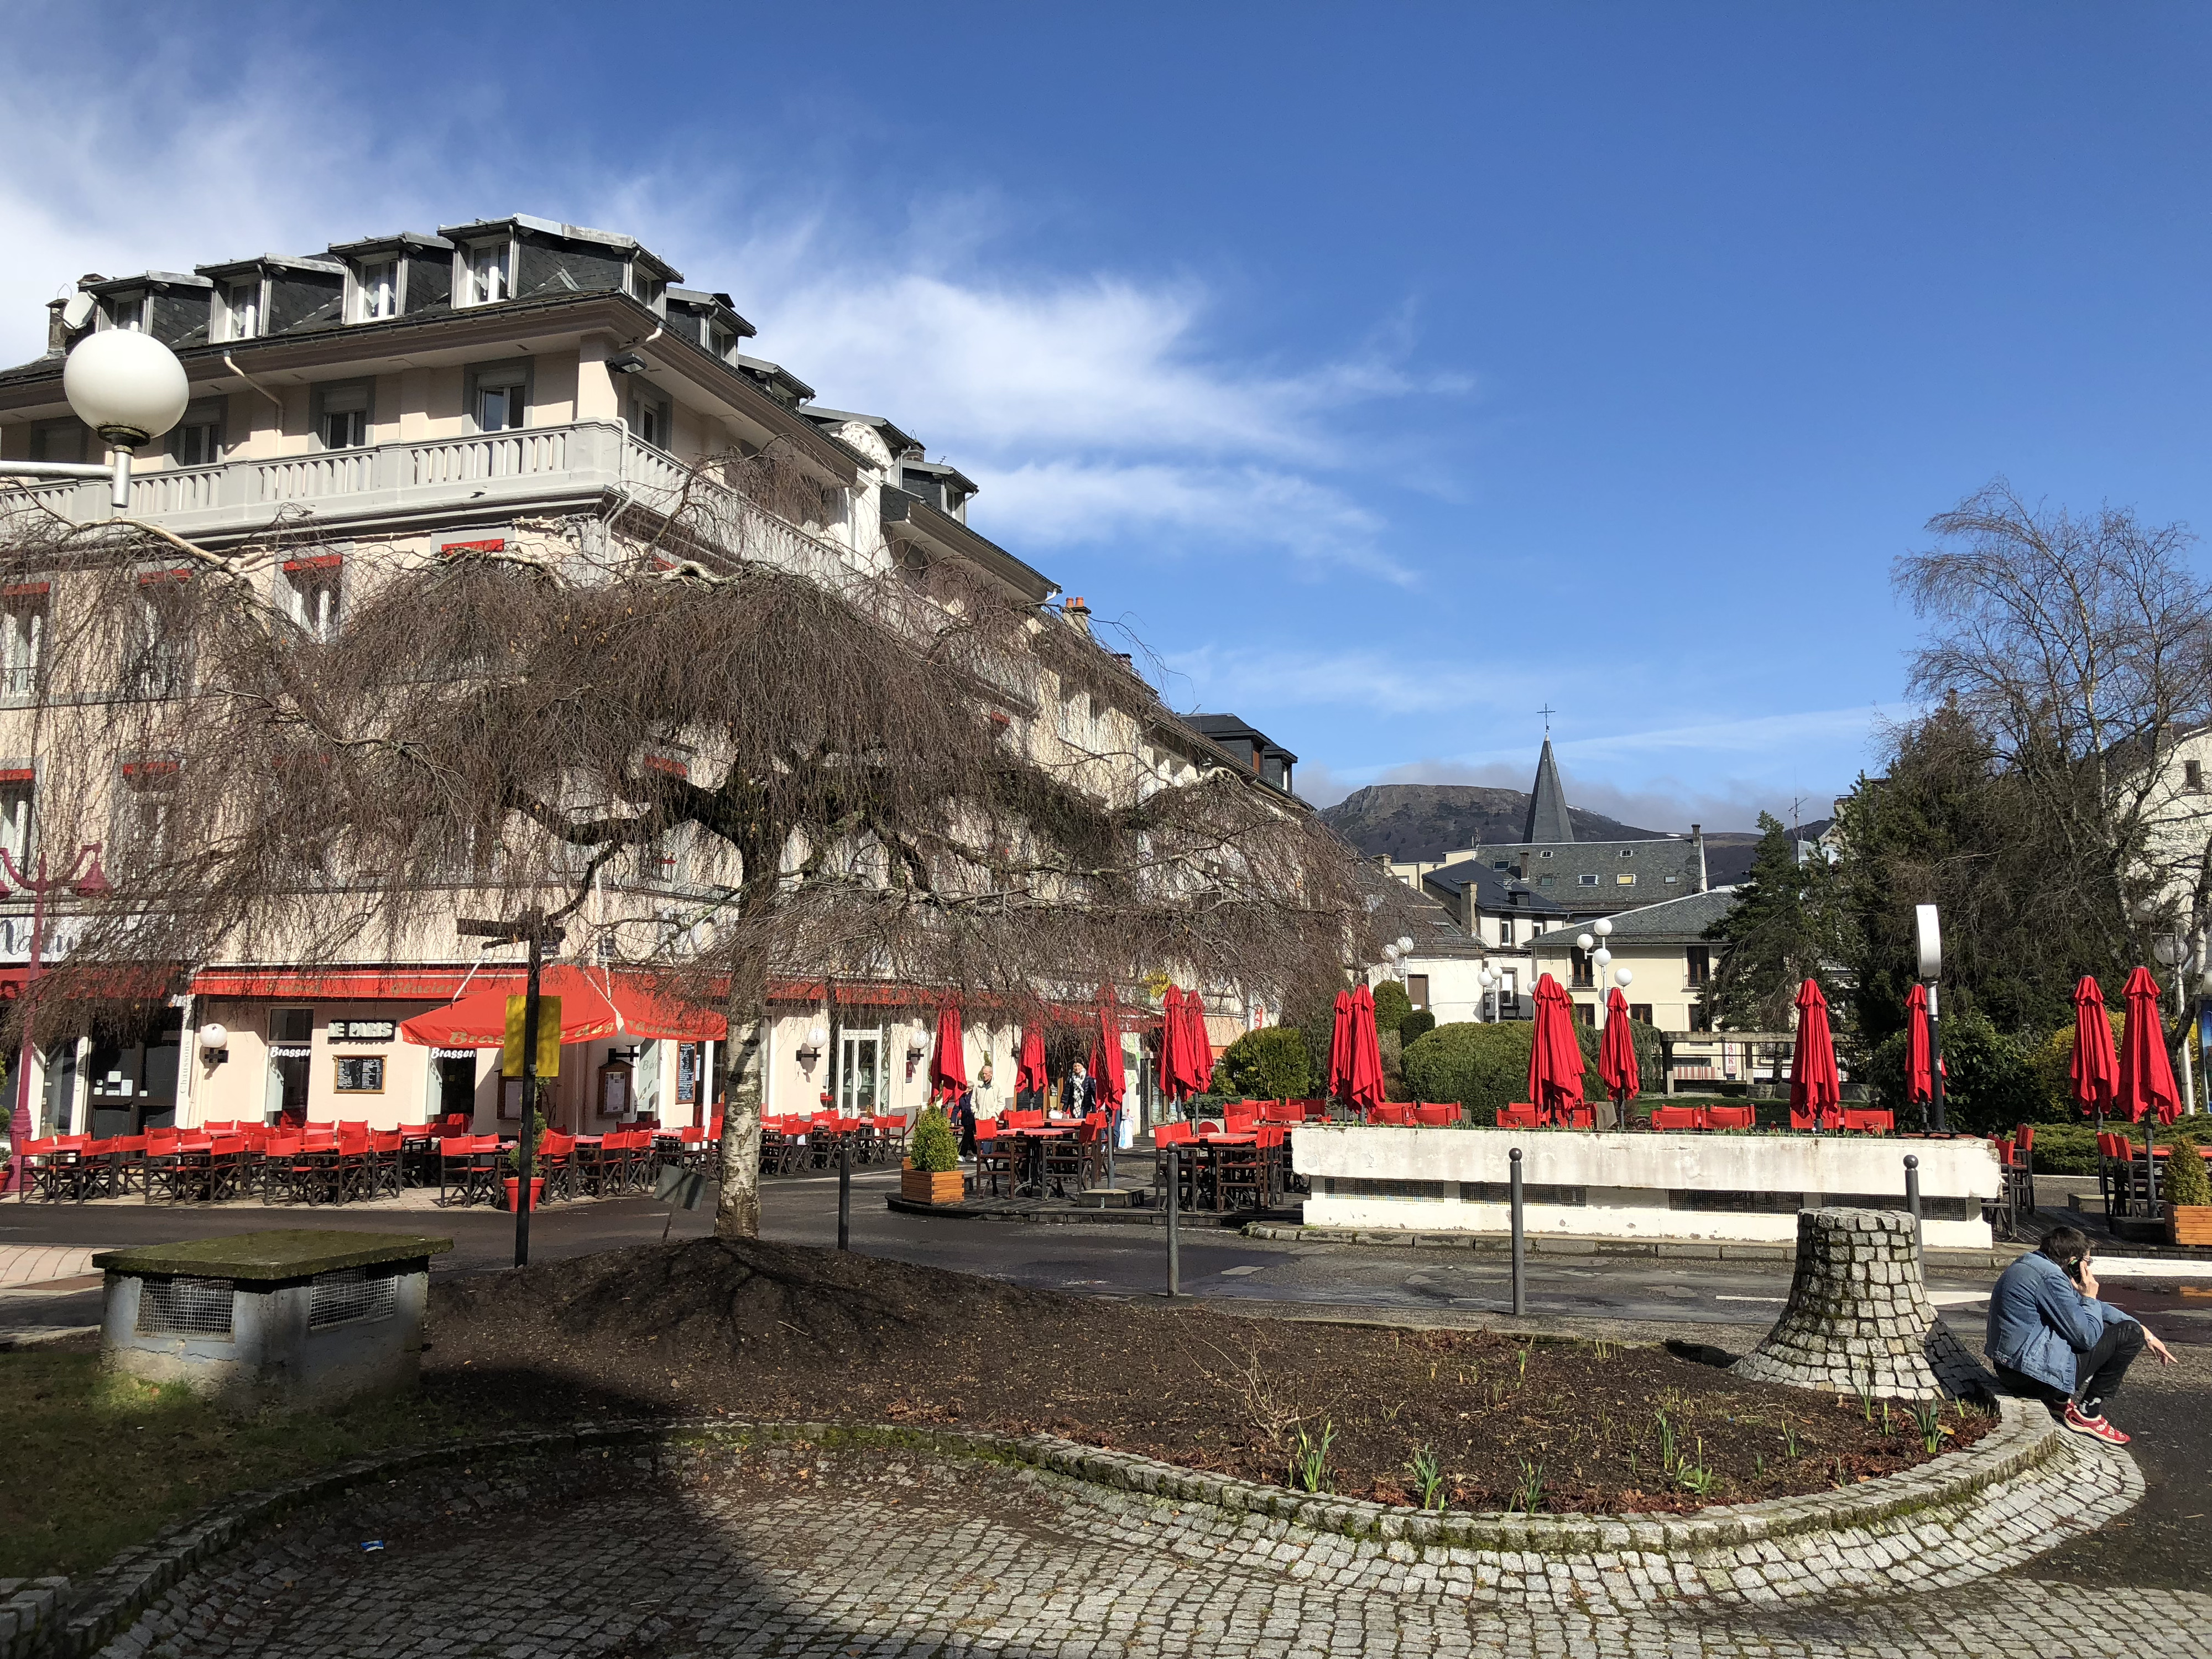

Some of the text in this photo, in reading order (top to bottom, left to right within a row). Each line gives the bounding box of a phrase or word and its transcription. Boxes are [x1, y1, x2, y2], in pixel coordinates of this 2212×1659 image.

[391, 982, 452, 996] Glacier
[328, 1022, 393, 1037] LE PARIS
[180, 1041, 191, 1094] Chaussons
